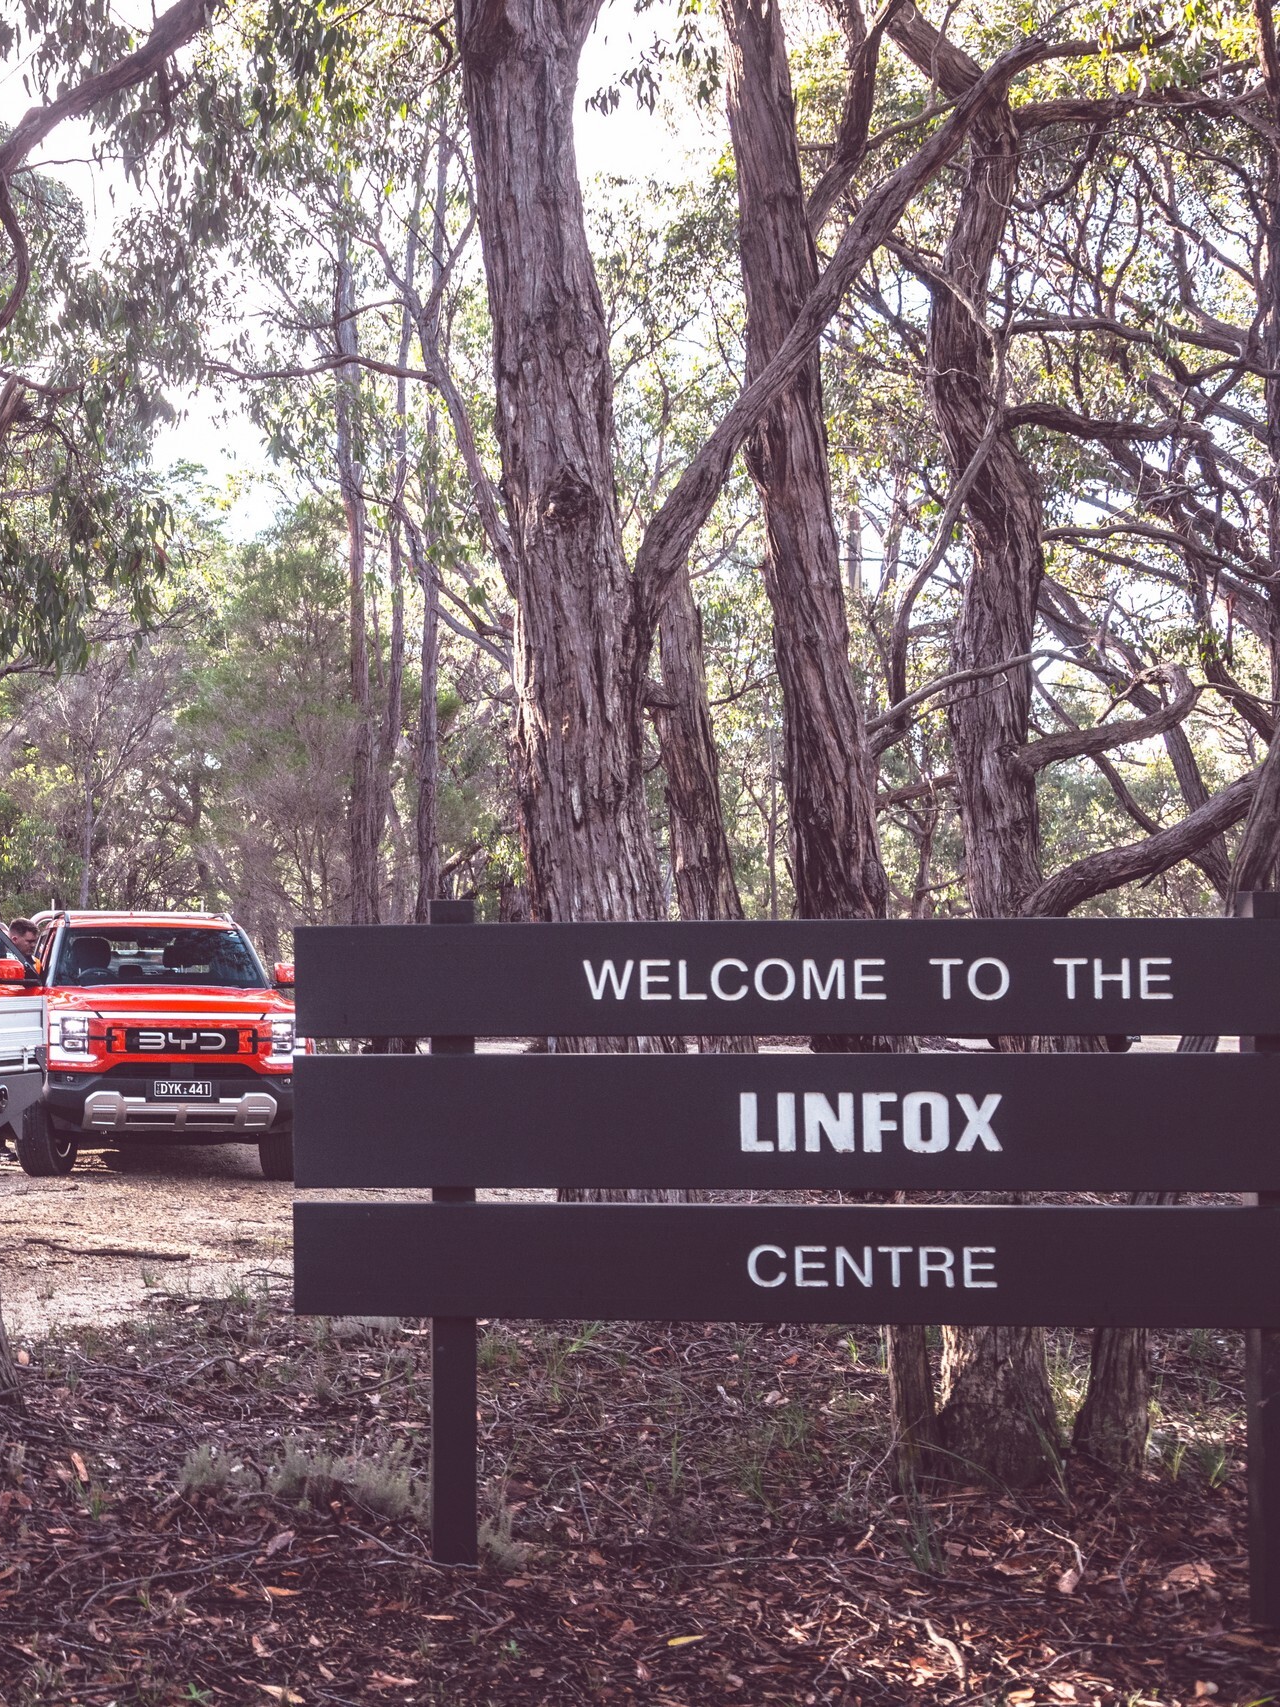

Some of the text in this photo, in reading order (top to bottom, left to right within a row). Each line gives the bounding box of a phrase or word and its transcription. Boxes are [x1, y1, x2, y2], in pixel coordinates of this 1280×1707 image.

[582, 957, 1174, 1002] WELCOME TO THE
[139, 1032, 227, 1050] BYD
[160, 1083, 209, 1095] DYK 441
[739, 1091, 1003, 1154] LINFOX
[747, 1244, 998, 1289] CENTRE
